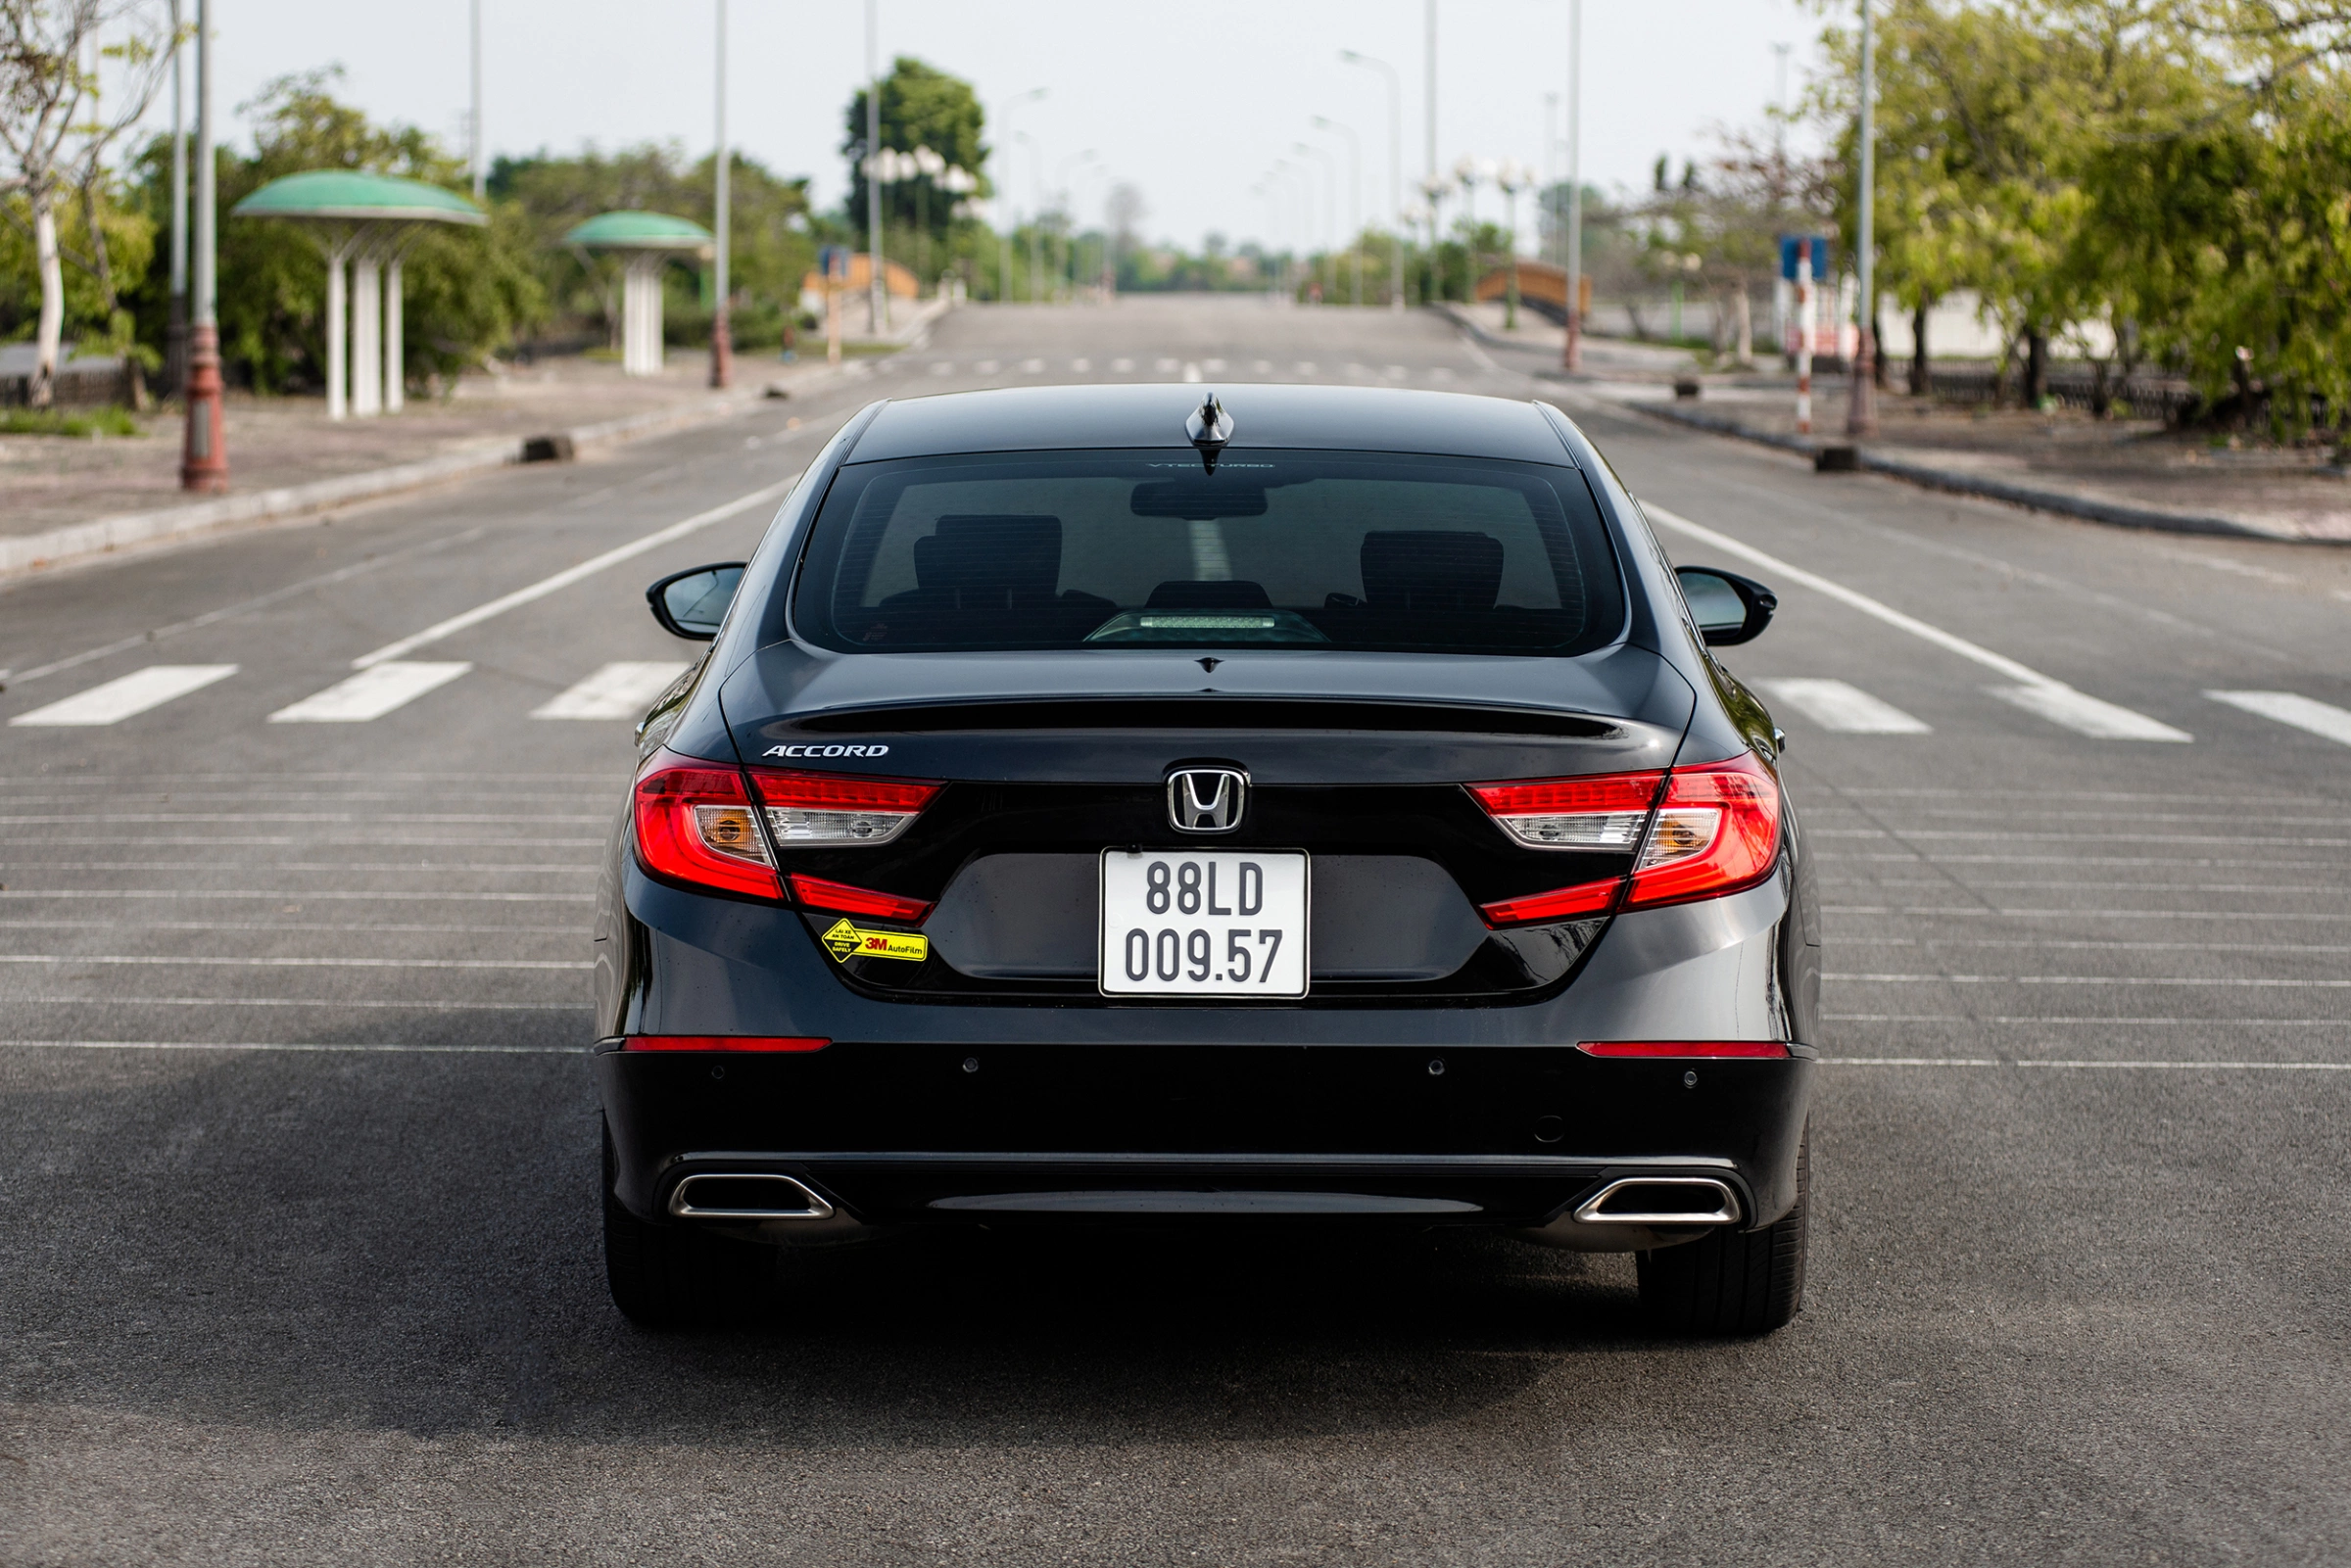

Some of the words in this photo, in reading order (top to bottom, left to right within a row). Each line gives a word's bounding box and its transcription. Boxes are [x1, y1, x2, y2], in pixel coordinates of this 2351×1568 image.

[761, 744, 889, 758] ACCORD
[1146, 861, 1264, 916] 88LD
[865, 936, 888, 951] 3M
[888, 944, 923, 955] AutoFilm
[1125, 927, 1283, 983] 009.57
